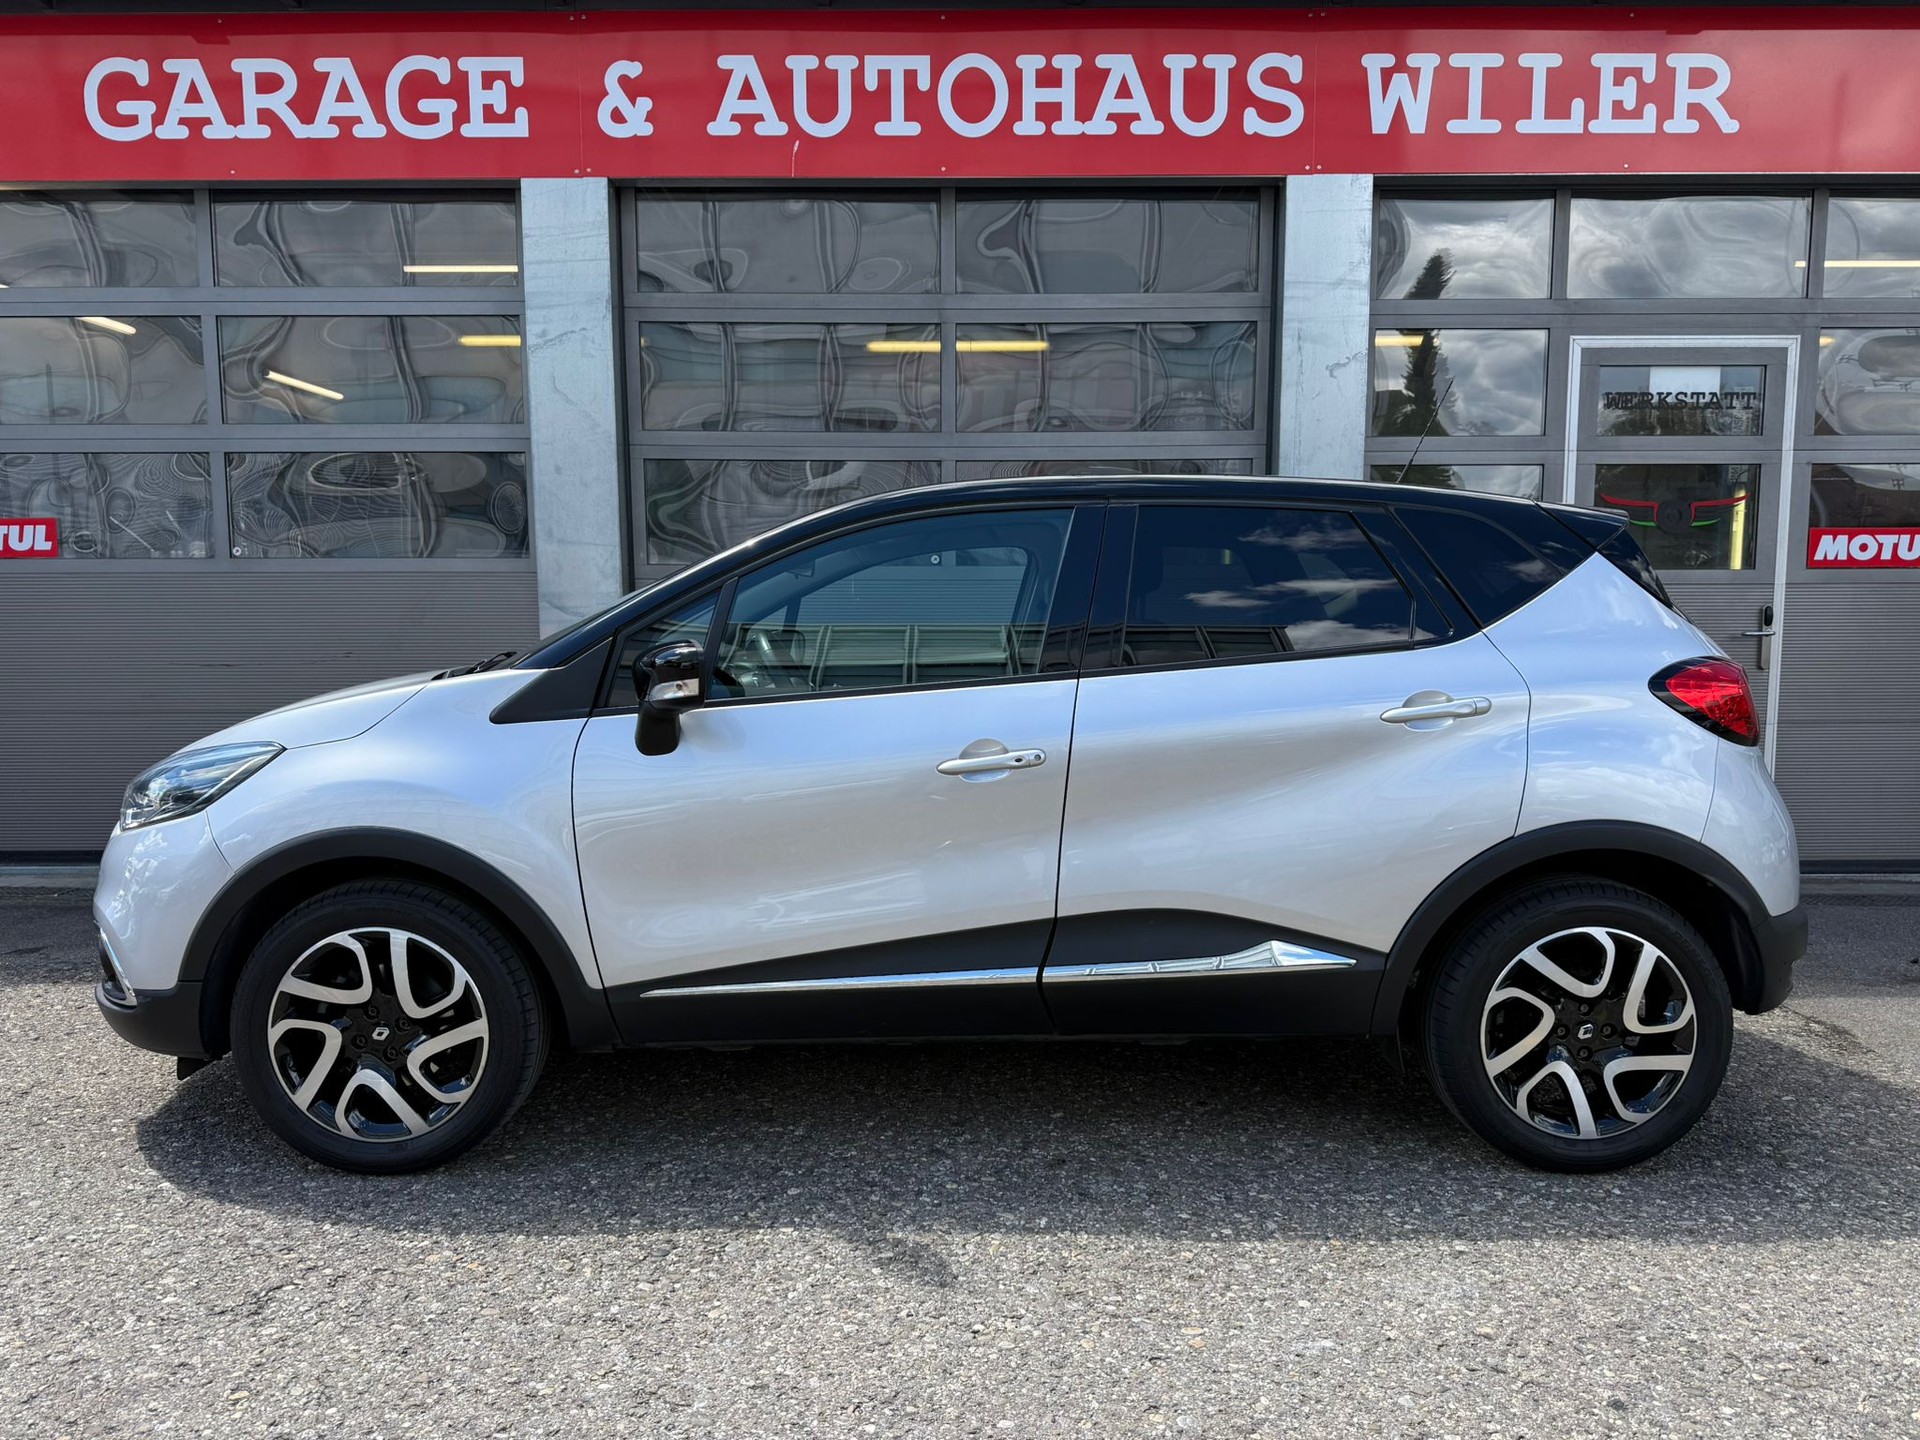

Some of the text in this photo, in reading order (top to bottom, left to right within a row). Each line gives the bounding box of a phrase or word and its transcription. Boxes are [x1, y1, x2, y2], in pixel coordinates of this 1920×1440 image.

[83, 52, 1741, 142] GARAGE & AUTOHAUS WILER
[1603, 391, 1757, 410] WERKSTATT
